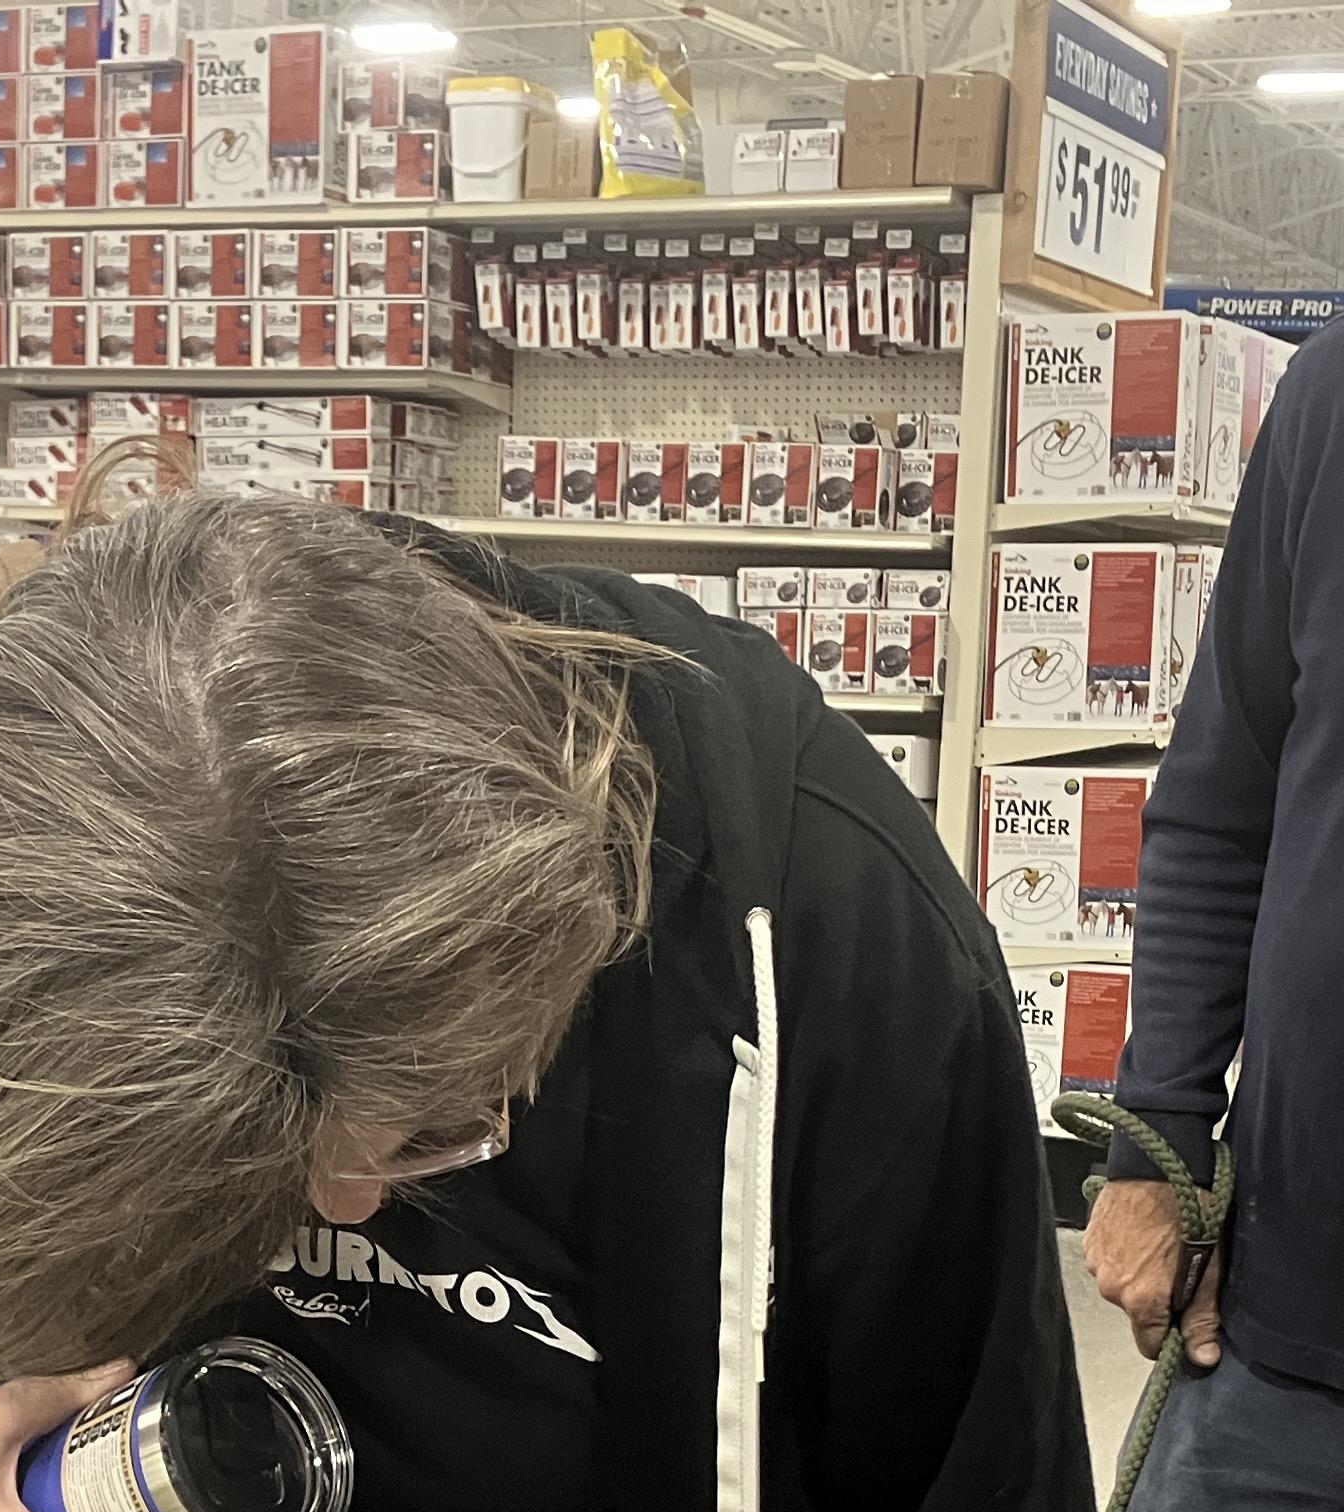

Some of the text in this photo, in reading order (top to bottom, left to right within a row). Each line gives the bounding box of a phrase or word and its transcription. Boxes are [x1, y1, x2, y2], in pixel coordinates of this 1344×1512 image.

[197, 60, 246, 78] TANK
[197, 77, 260, 97] DE-ICER
[1210, 297, 1333, 317] POWER PRO
[1024, 347, 1084, 365] TANK
[1024, 366, 1102, 385] DE-ICER
[1003, 576, 1061, 594] TANK
[1003, 595, 1079, 613] DE-ICER
[995, 799, 1053, 817] TANK
[994, 817, 1070, 836] DE-ICER
